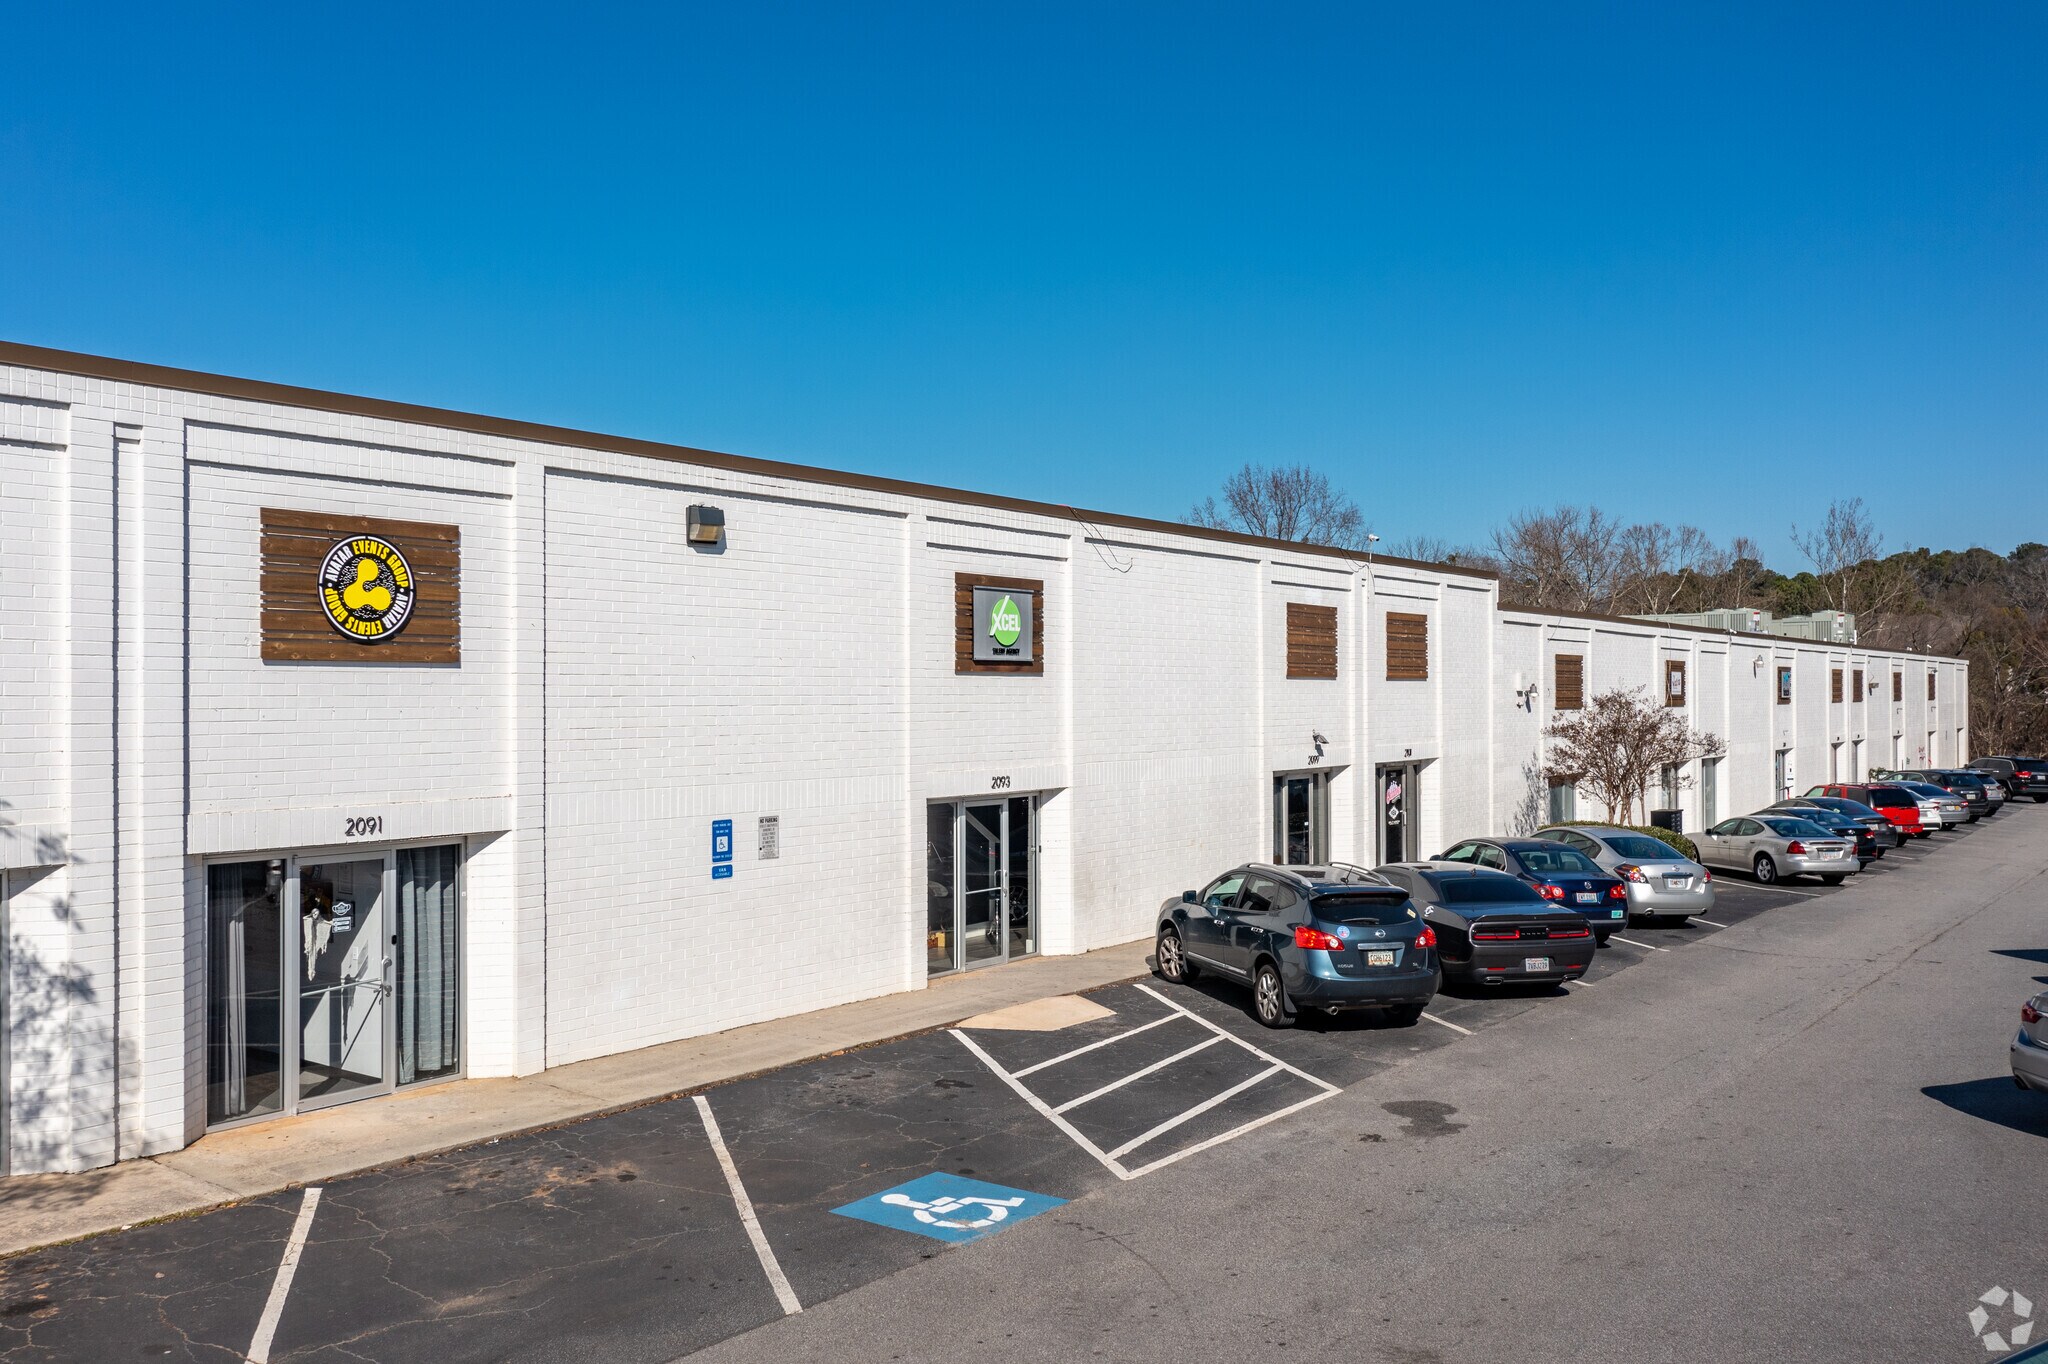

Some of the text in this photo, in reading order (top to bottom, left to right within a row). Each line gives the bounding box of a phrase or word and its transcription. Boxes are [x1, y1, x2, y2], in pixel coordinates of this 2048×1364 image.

[325, 540, 409, 588] AVATAR EVENTS GROUP
[325, 588, 409, 635] AVATAR EVENTS GROUP
[989, 595, 1021, 636] XCEL
[1006, 648, 1020, 656] AGENCY
[991, 775, 1011, 790] 2093
[344, 816, 382, 837] 2091
